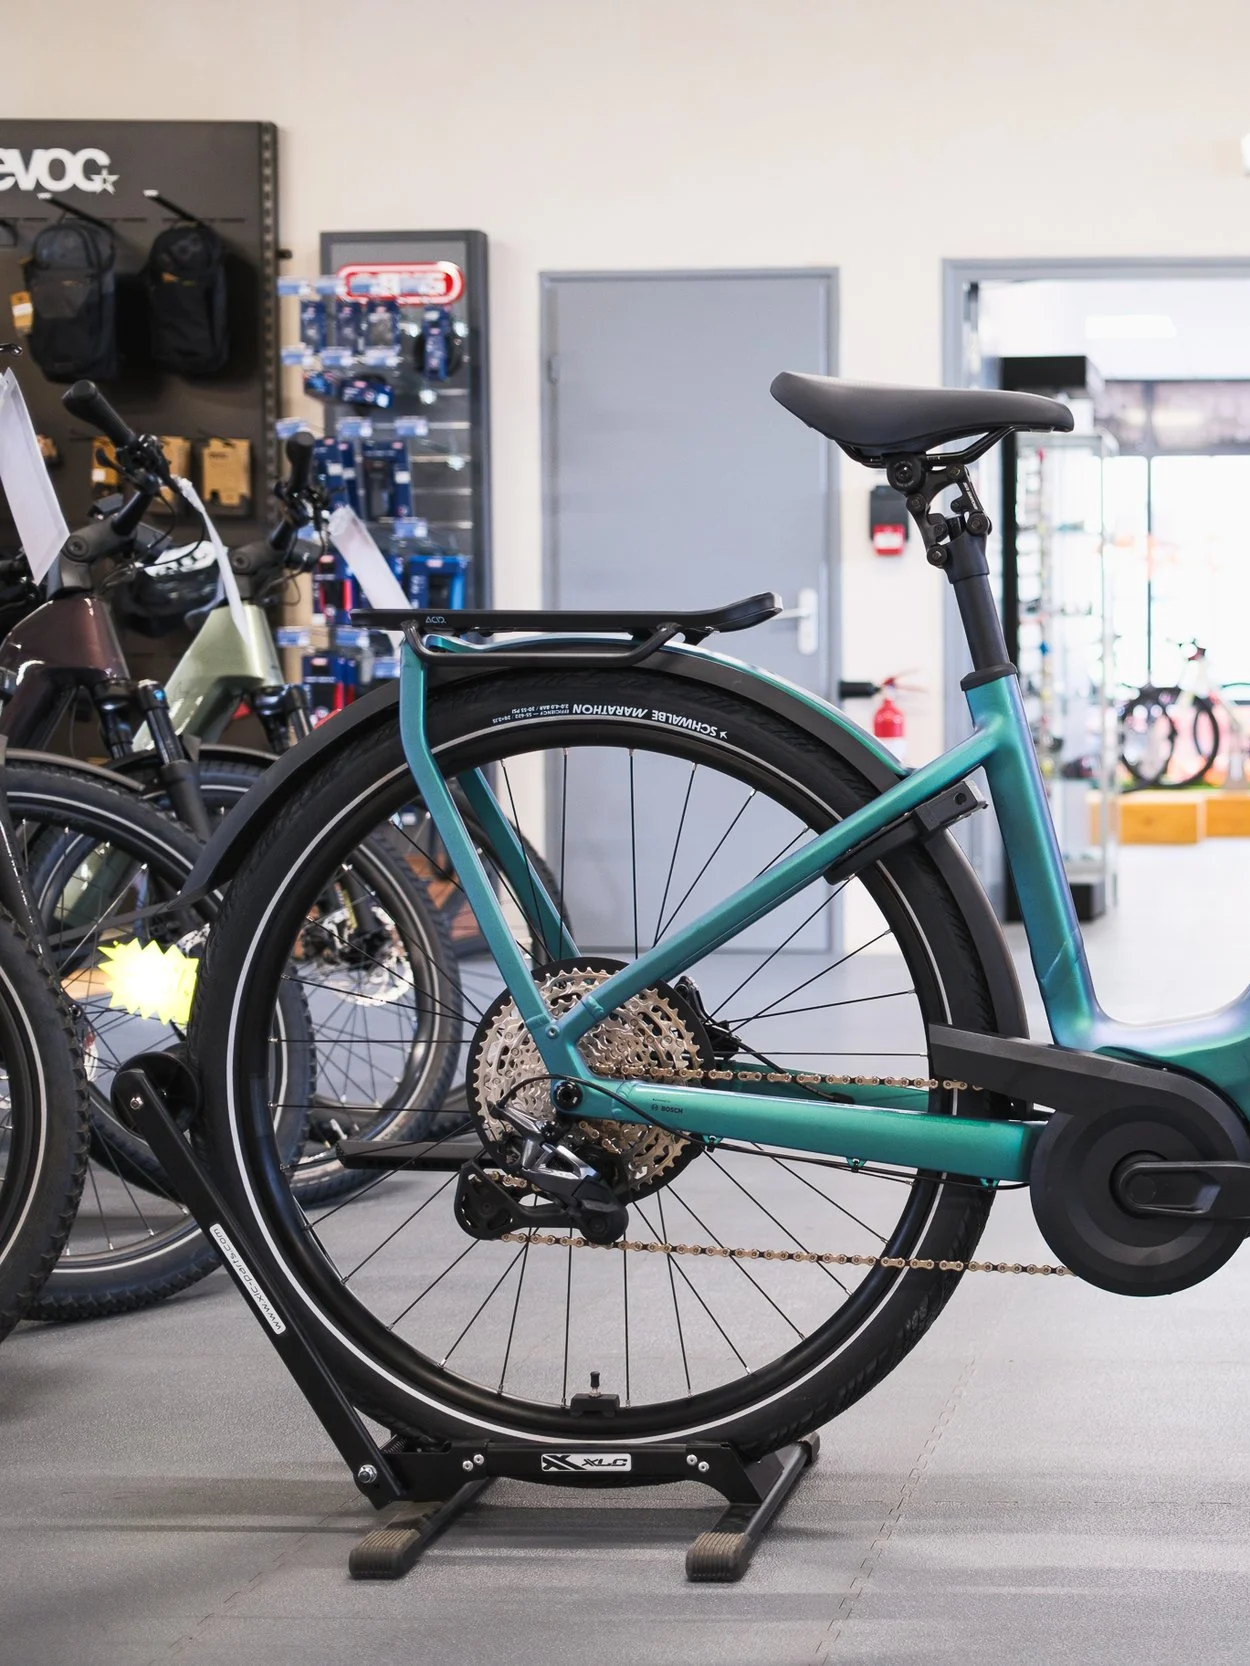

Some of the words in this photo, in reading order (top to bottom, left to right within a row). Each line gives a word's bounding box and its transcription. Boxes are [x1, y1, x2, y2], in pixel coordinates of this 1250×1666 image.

[572, 703, 649, 718] MARATHON
[651, 709, 718, 737] SCHWALBE
[661, 1106, 683, 1114] BOSCH
[213, 1228, 281, 1330] www.xlc-parts.com
[581, 1458, 628, 1467] XLC
